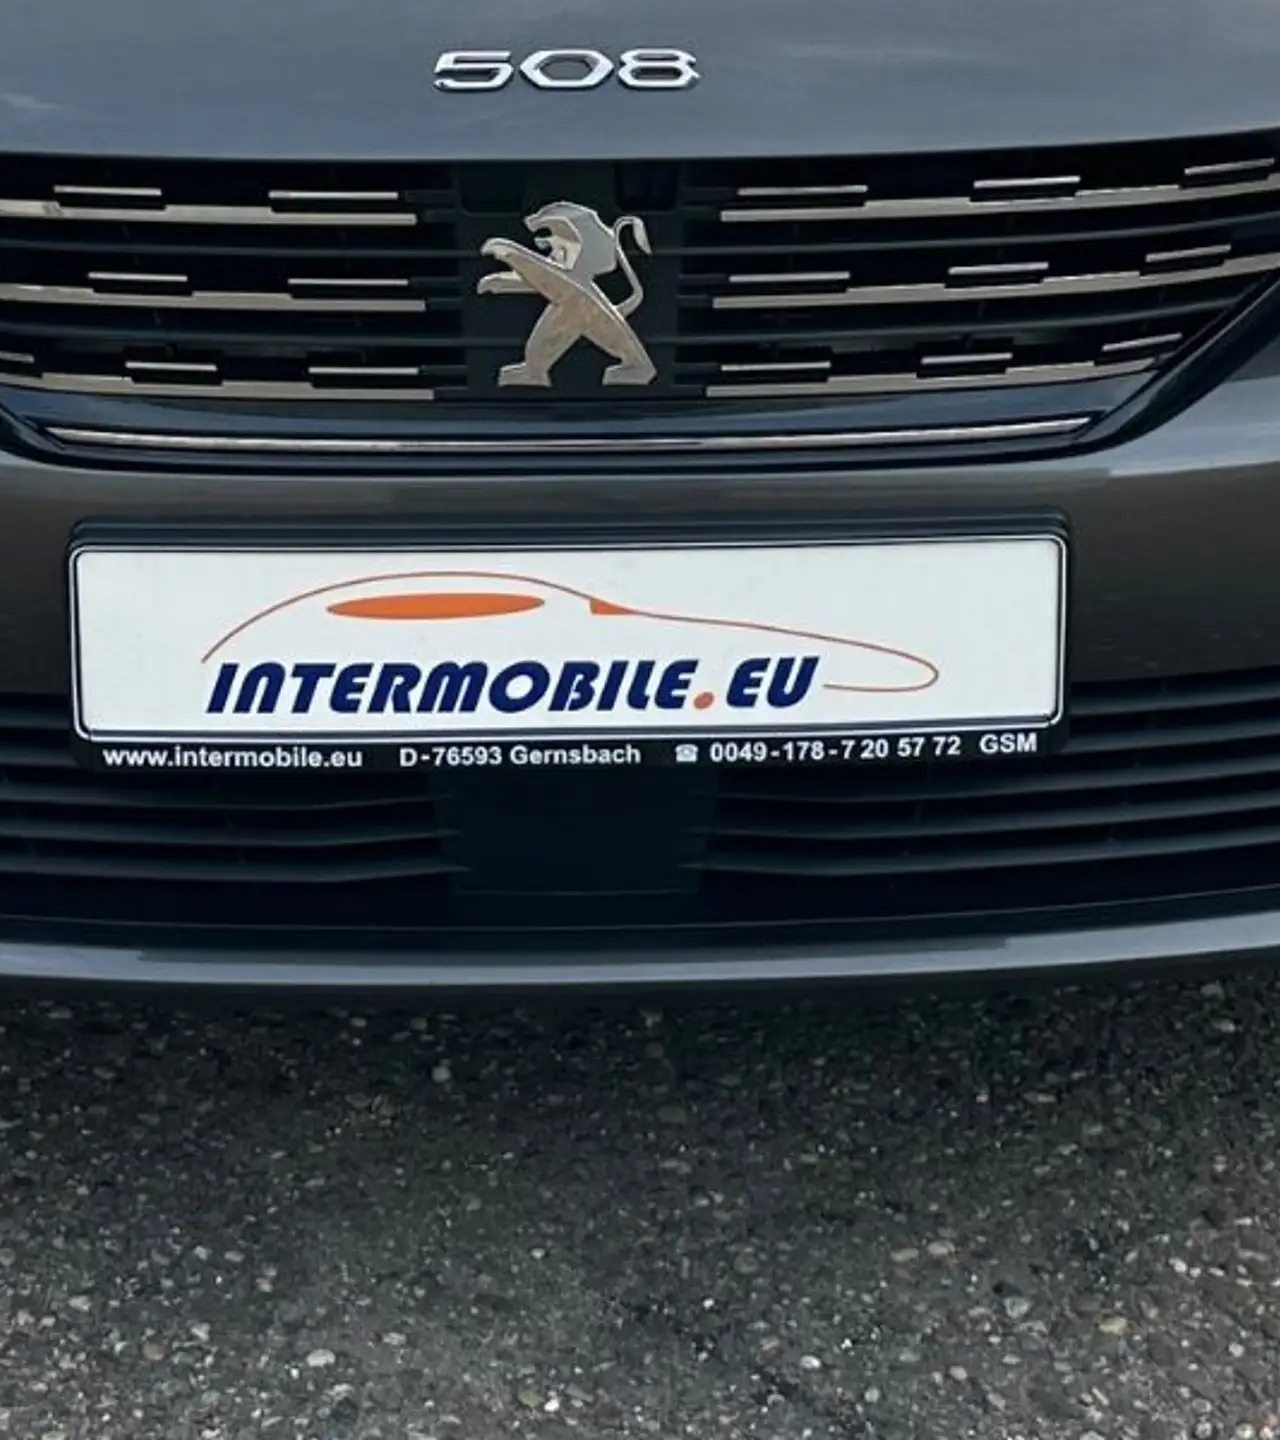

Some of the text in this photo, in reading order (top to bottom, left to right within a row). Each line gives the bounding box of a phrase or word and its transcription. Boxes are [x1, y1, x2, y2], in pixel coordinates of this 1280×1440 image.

[433, 48, 700, 91] 508
[205, 657, 820, 714] INTERMOBILE.EU
[102, 745, 363, 768] www.intermobile.eu
[399, 745, 503, 768] D-76593
[509, 743, 642, 766] Gernsbach
[978, 732, 1038, 755] GSM
